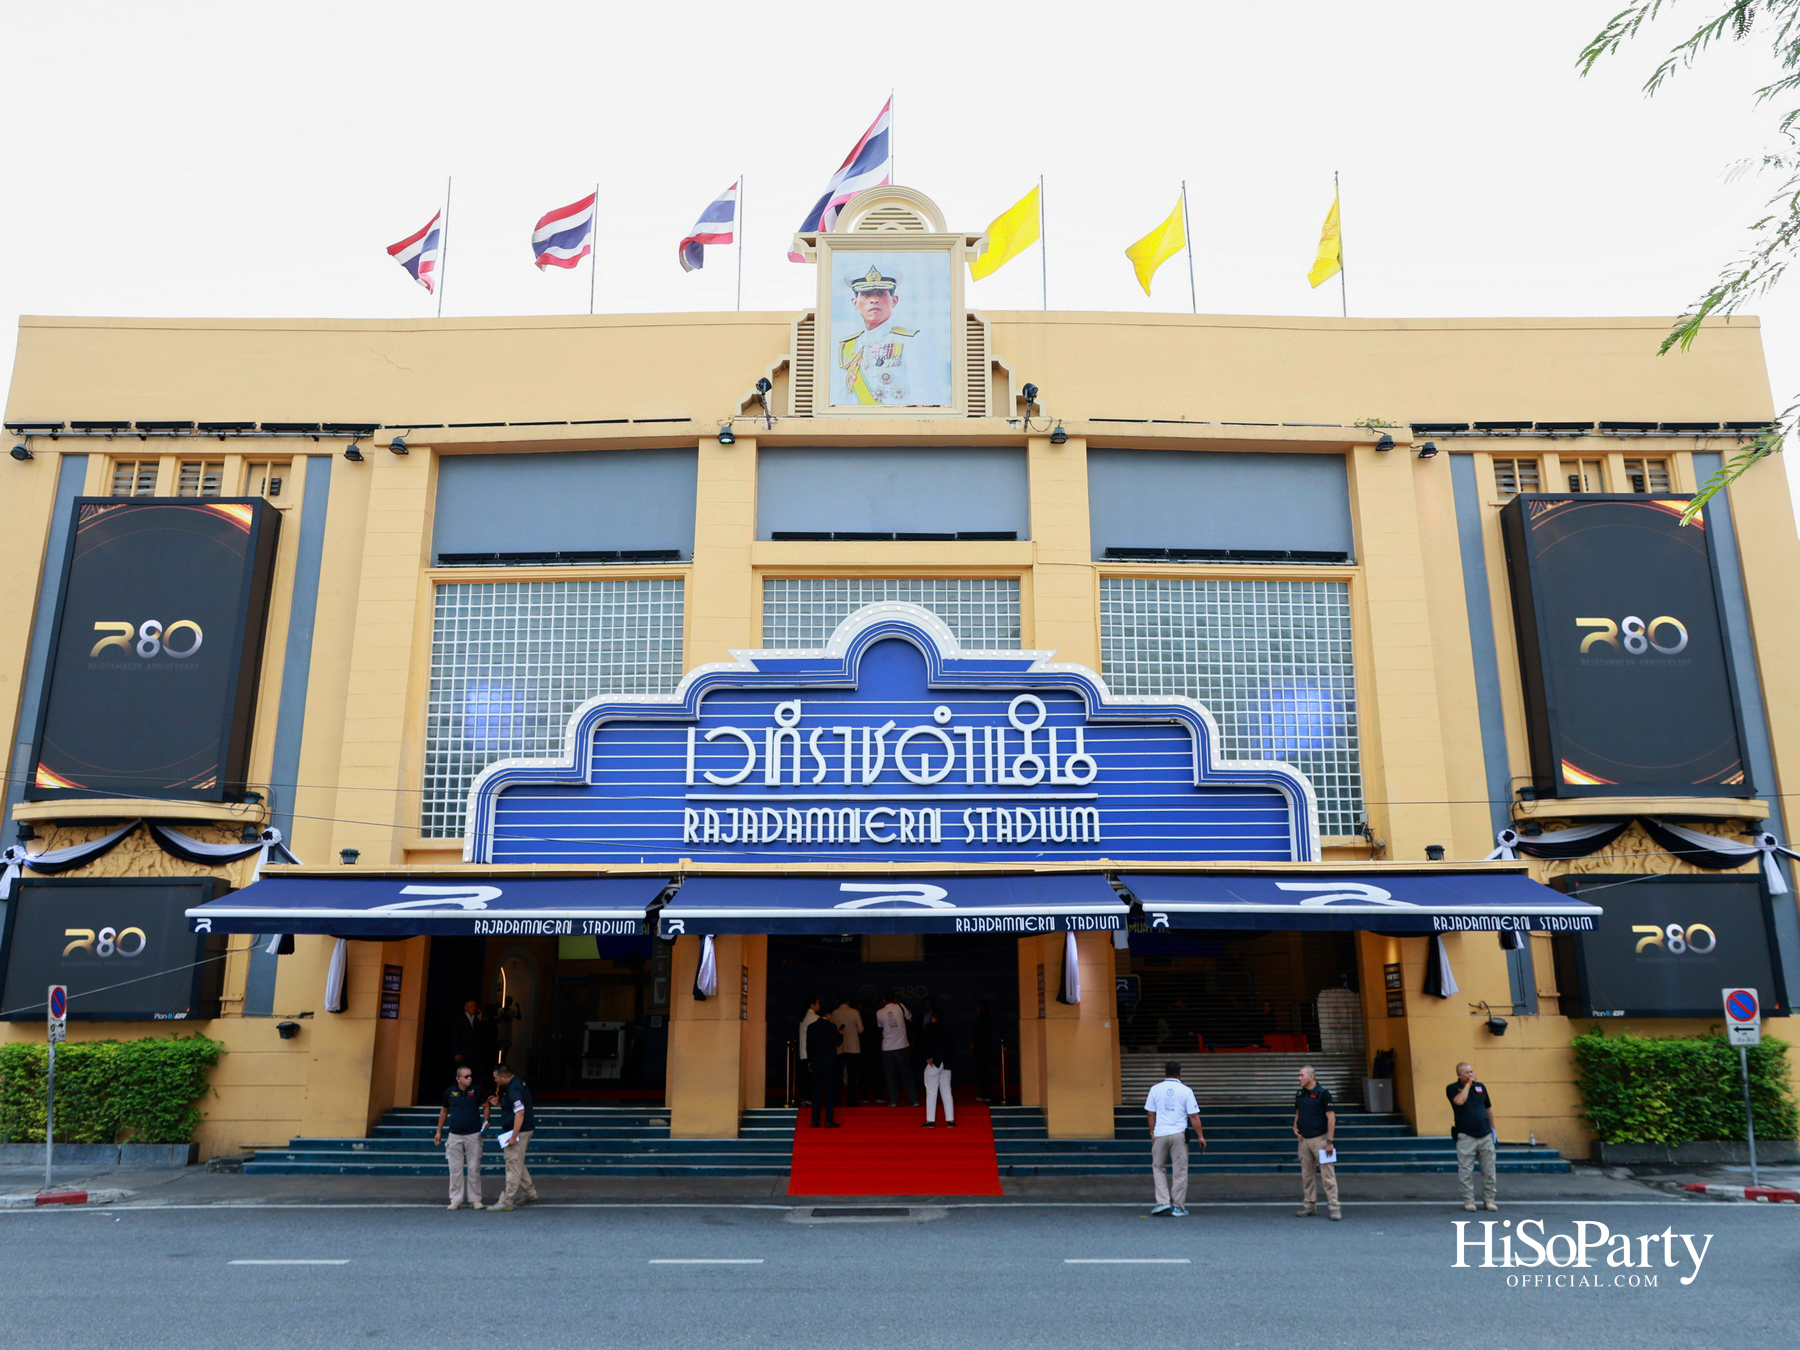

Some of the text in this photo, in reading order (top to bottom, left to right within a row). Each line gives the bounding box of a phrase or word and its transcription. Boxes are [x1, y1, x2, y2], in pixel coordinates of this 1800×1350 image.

[89, 619, 203, 659] R80
[1575, 615, 1689, 655] R80
[683, 805, 1101, 844] RAJADAMNERN STADIUM
[474, 919, 572, 935] RAJADAMNERN
[582, 919, 636, 935] STADIUM
[956, 915, 1120, 932] RAJADAMNERN STADIUM
[1433, 915, 1594, 931] RAJADAMNERN STADIUM
[1631, 923, 1717, 954] R80
[62, 926, 147, 958] R80
